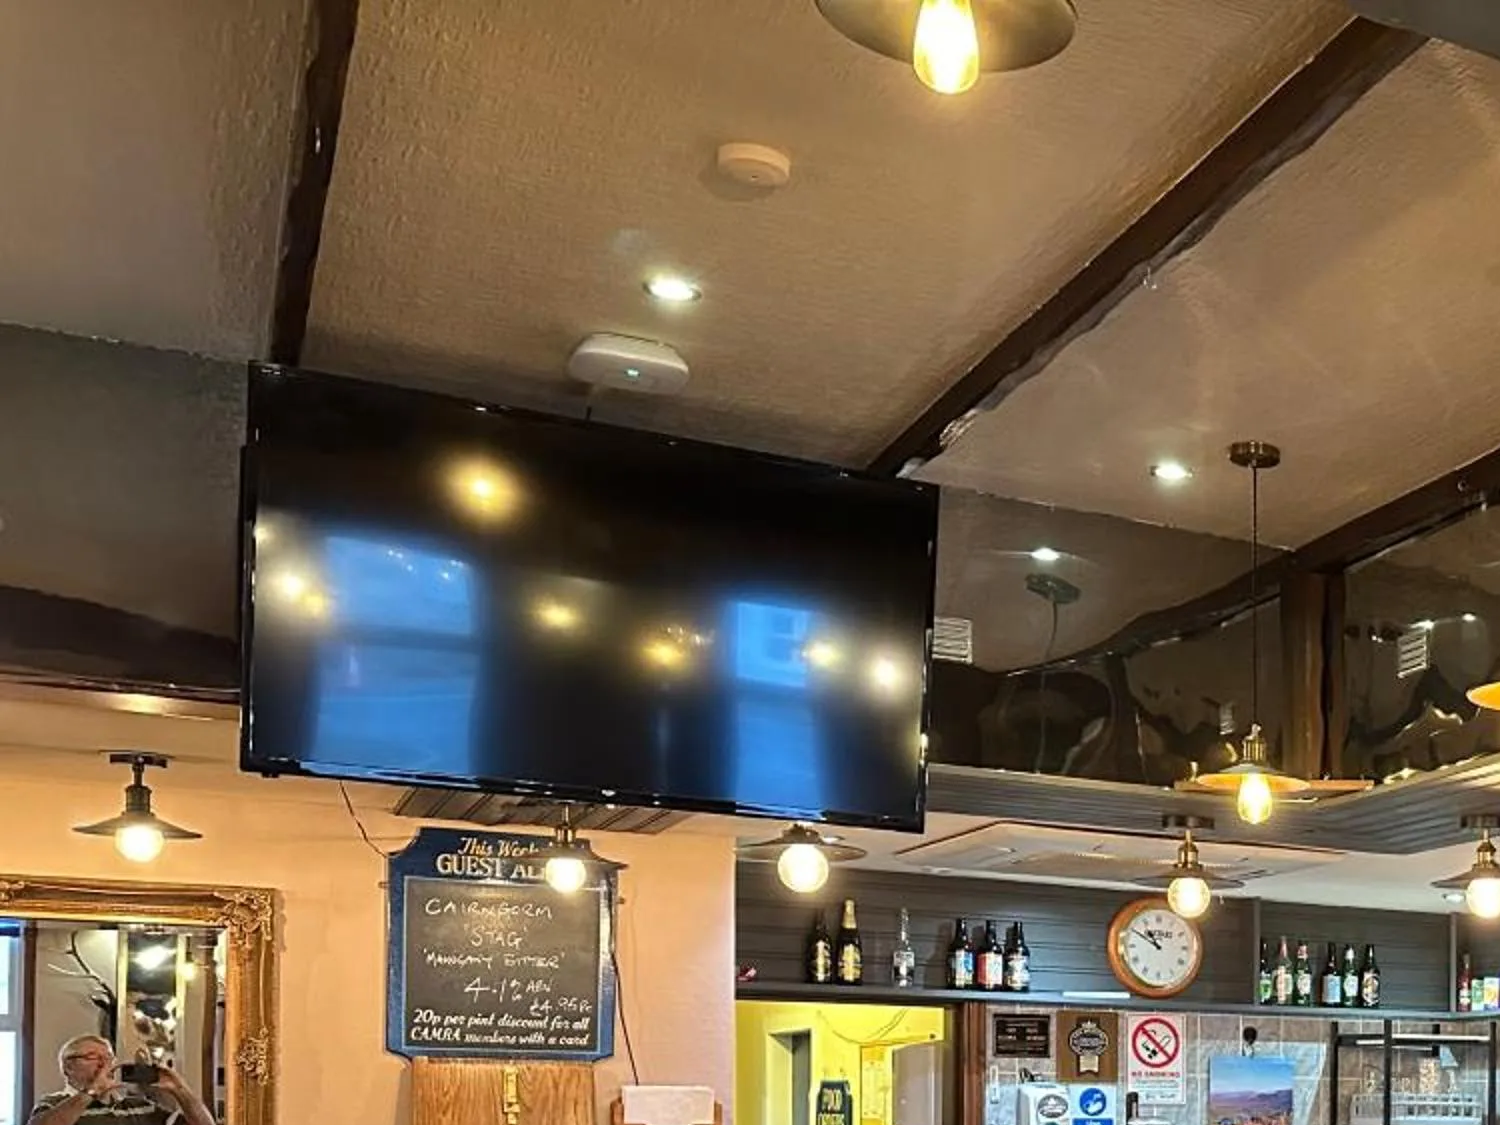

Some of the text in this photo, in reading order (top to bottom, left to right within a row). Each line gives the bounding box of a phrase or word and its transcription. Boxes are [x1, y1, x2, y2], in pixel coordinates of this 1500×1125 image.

[457, 836, 493, 856] This
[436, 853, 546, 880] GUEST AL
[424, 897, 553, 920] CAIRNGORM
[413, 1008, 590, 1032] 20p per pint discount for all
[411, 1026, 461, 1042] CAMRA
[463, 1031, 516, 1044] members
[518, 1031, 546, 1045] with
[558, 1033, 589, 1046] card
